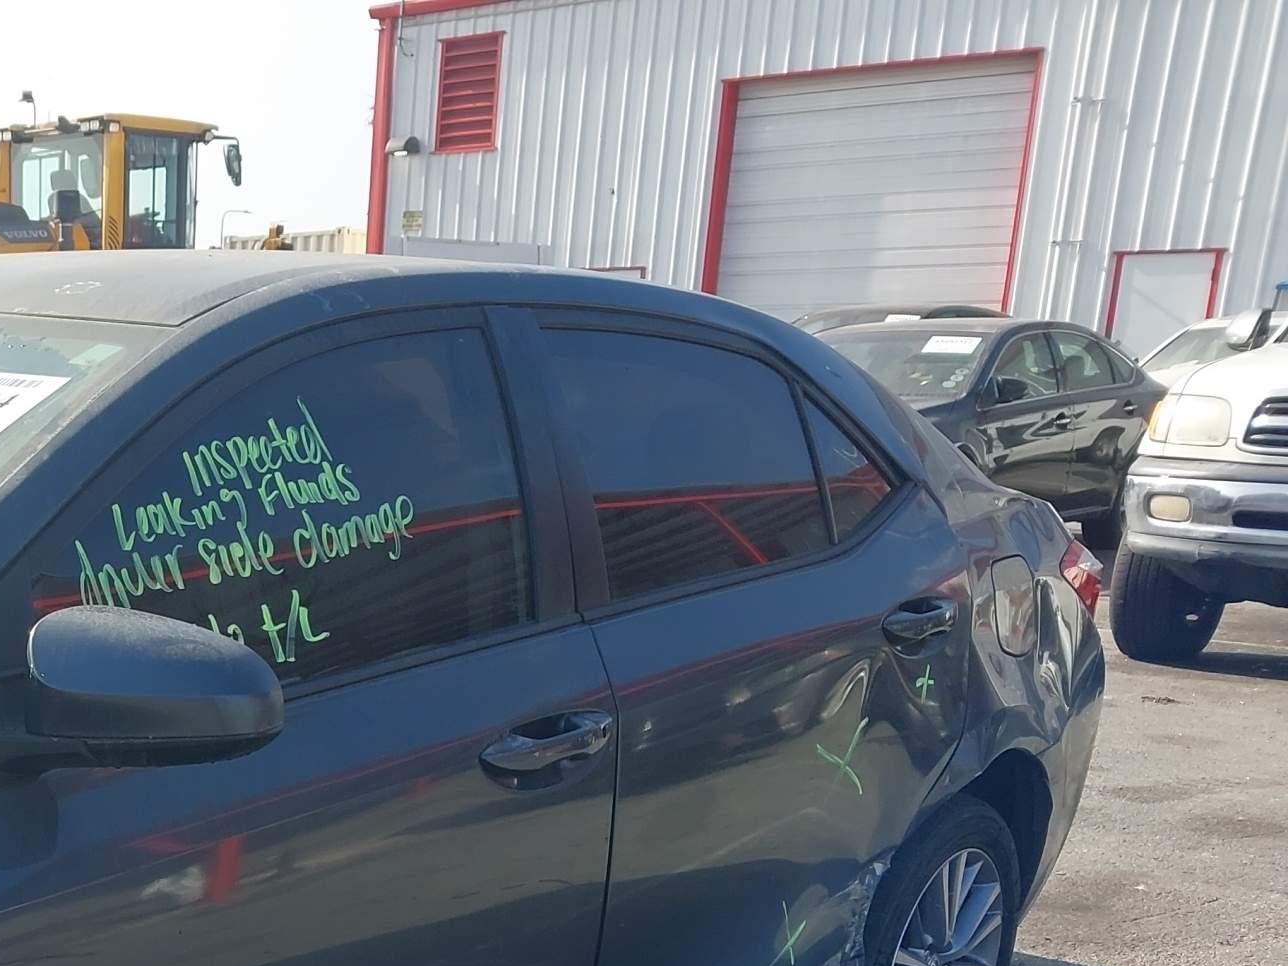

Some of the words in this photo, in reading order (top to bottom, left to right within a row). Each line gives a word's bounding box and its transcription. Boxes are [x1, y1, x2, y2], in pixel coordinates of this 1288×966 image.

[5, 230, 48, 239] VOLVO
[112, 488, 247, 551] Leaking
[198, 521, 285, 585] side
[294, 494, 414, 562] damage
